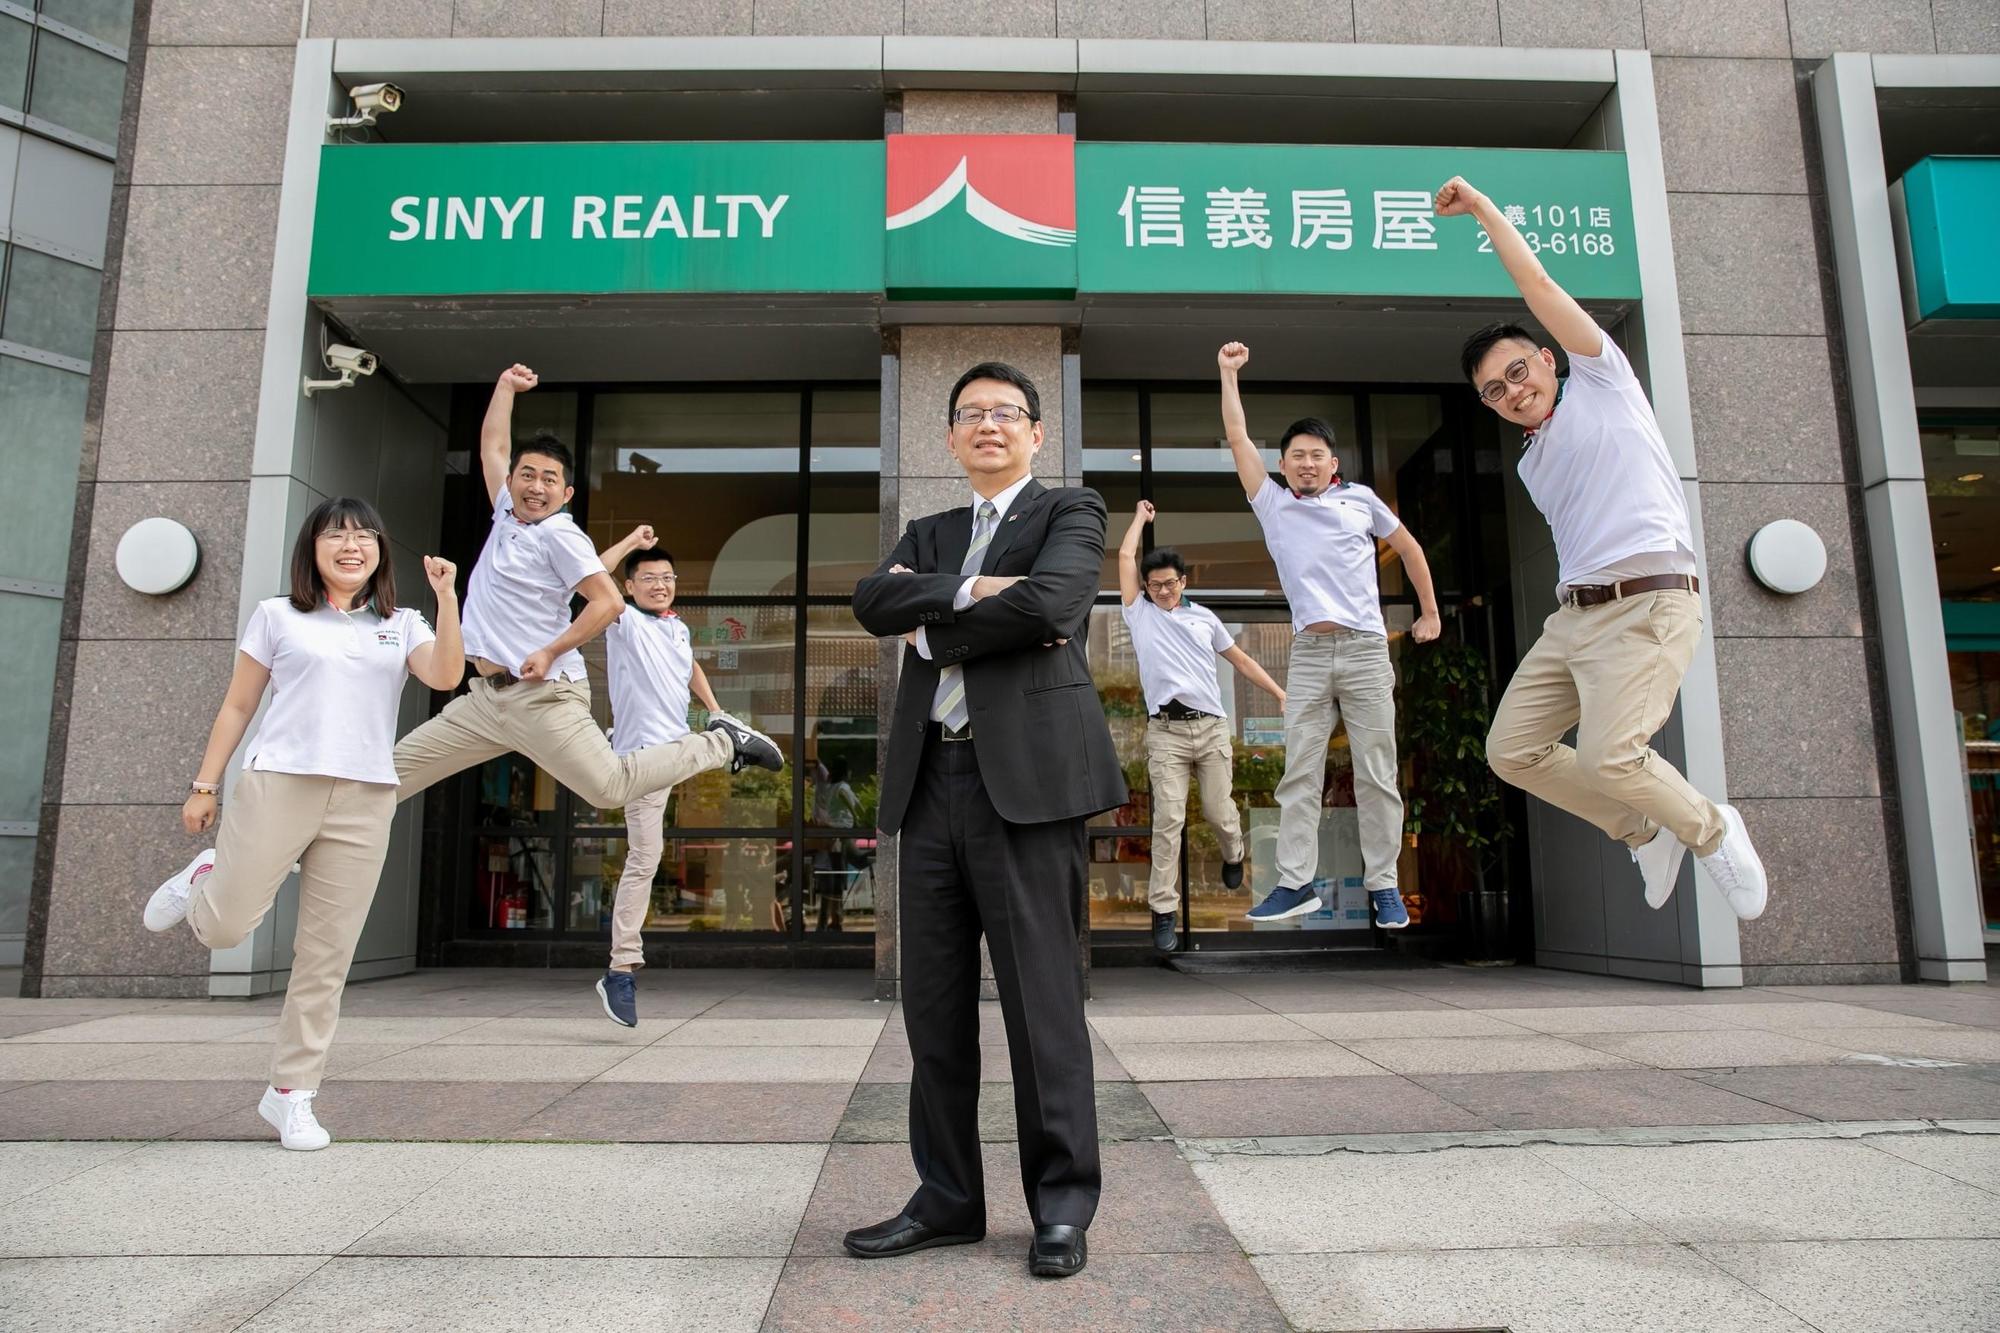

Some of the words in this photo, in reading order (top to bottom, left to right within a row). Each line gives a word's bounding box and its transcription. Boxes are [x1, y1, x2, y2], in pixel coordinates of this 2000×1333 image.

[389, 196, 544, 241] SINYI
[572, 194, 789, 239] REALTY
[1118, 186, 1438, 250] 信義房屋
[1477, 204, 1611, 228] 義101店
[1476, 230, 1615, 256] 23-6168
